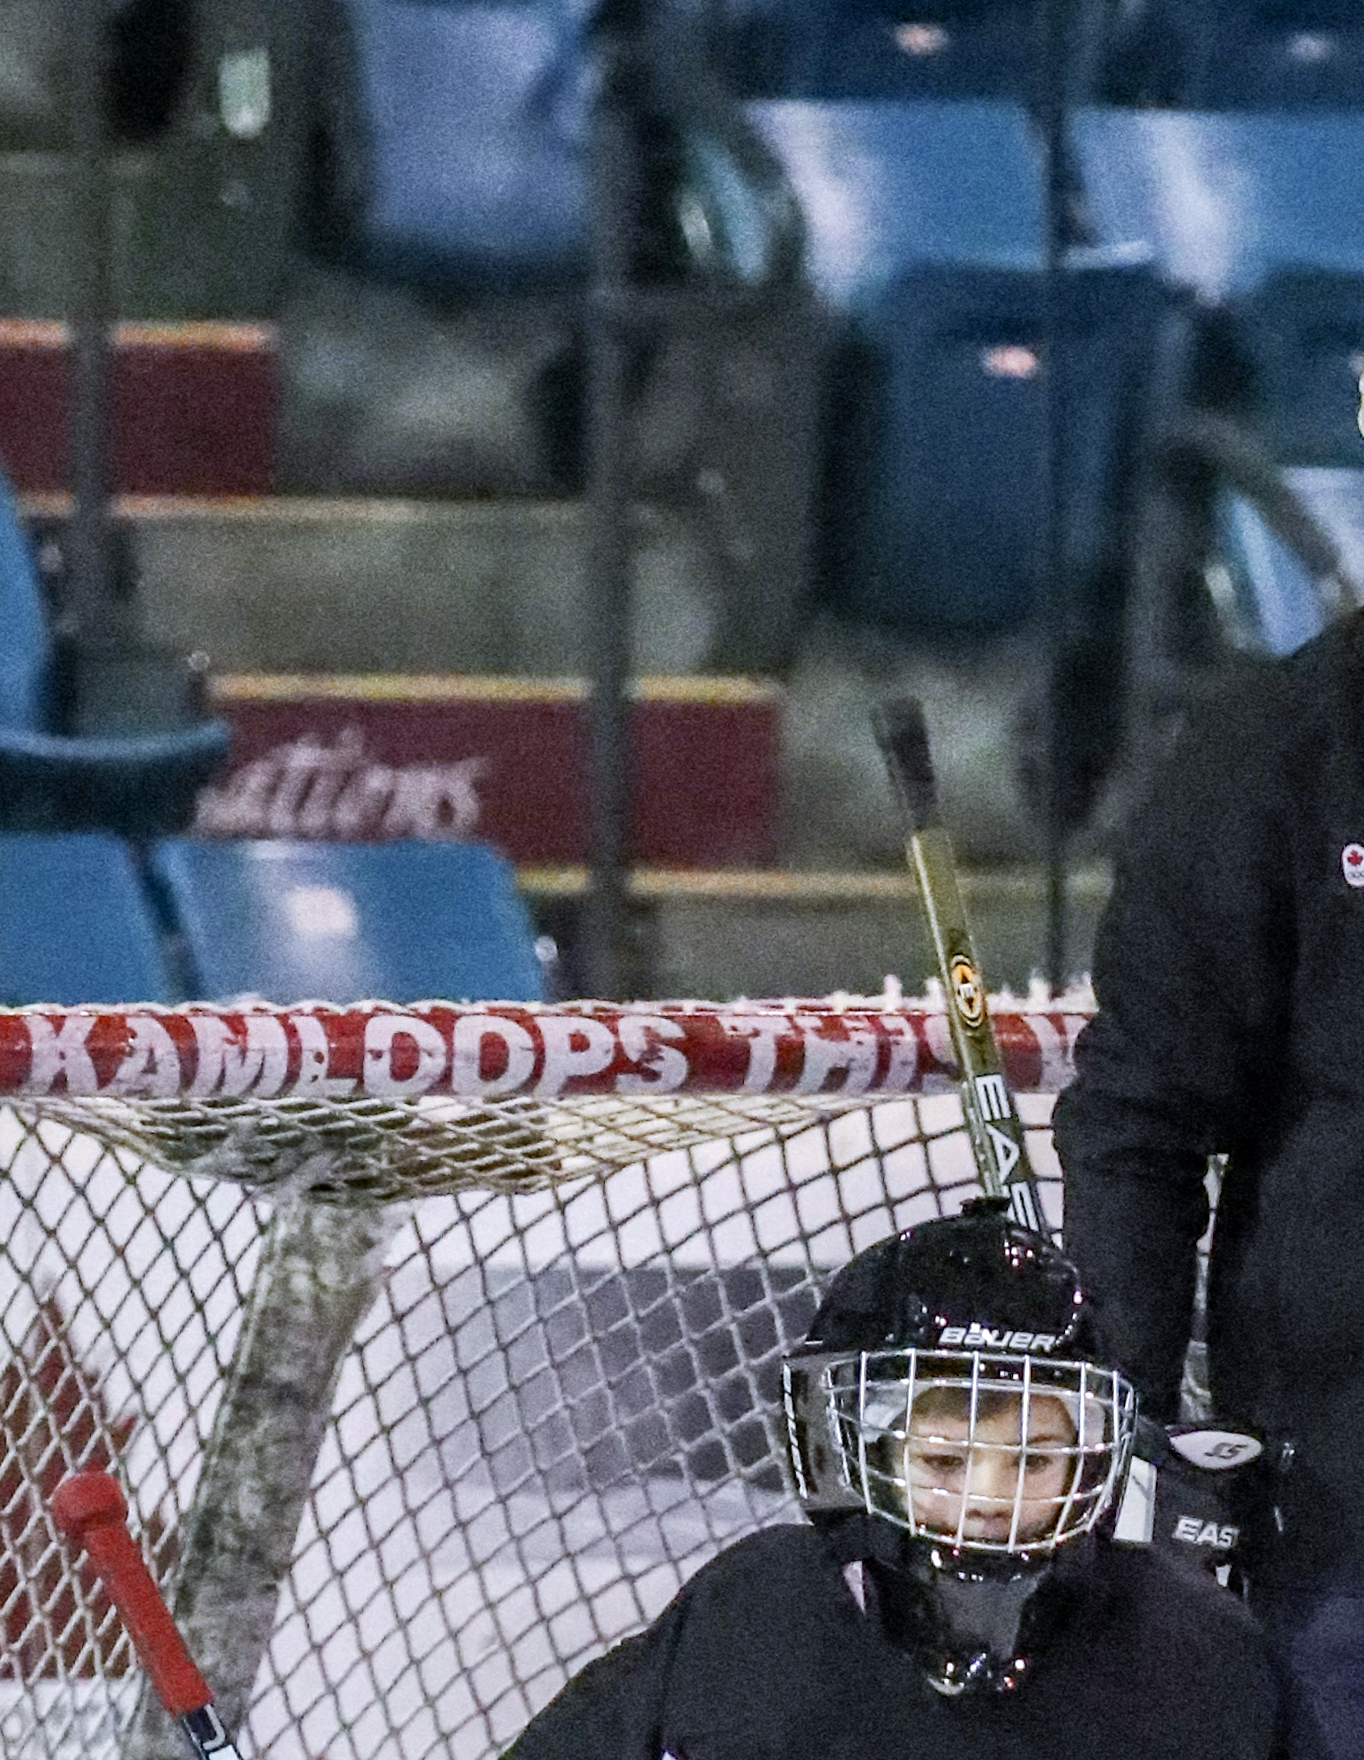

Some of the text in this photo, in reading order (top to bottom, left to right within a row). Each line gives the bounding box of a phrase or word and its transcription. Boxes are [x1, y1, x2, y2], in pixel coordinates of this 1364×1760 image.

[25, 1013, 690, 1098] KAMLOOPS
[939, 1325, 1056, 1353] BAUER
[1172, 1514, 1241, 1549] EAS
